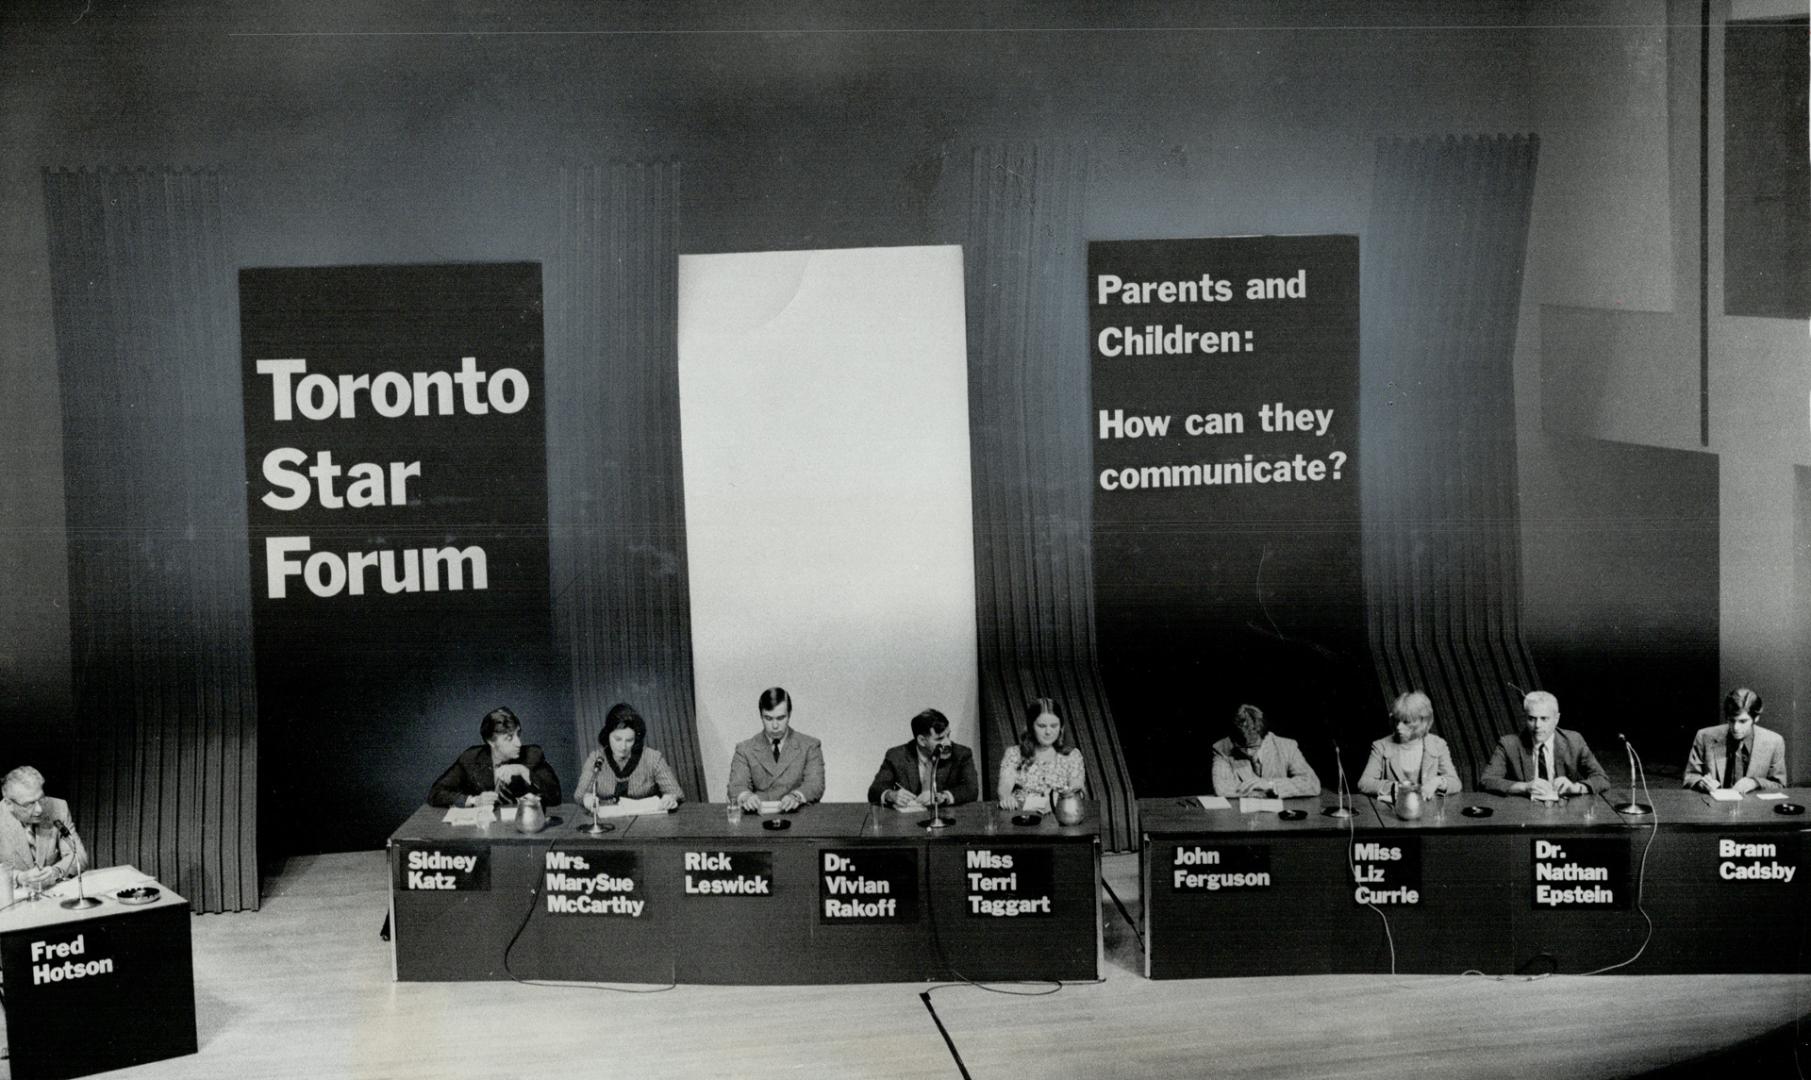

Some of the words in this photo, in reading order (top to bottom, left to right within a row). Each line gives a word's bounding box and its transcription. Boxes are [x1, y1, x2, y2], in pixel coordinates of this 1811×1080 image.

[1098, 274, 1232, 304] Parents
[1247, 270, 1306, 299] and
[1098, 325, 1253, 356] Children:
[257, 357, 529, 420] Toronto
[1100, 410, 1171, 439] How
[1185, 413, 1243, 435] can
[1259, 403, 1333, 436] they
[261, 447, 421, 511] Star
[1100, 451, 1346, 490] communicate?
[266, 536, 487, 598] Forum
[1174, 847, 1219, 865] John
[1355, 843, 1402, 861] Miss
[1536, 841, 1566, 858] Dr.
[1720, 840, 1776, 857] Bram
[408, 851, 476, 872] Sidney
[546, 852, 589, 869] Mrs.
[685, 852, 731, 870] Rick
[825, 853, 855, 871] Dr.
[967, 851, 1013, 868] Miss
[408, 871, 456, 889] Katz
[1174, 870, 1270, 890] Ferguson
[1355, 865, 1385, 882] Liz
[1536, 863, 1607, 880] Nathan
[1720, 861, 1795, 882] Cadsby
[546, 873, 634, 894] MarySue
[685, 875, 768, 893] Leswick
[825, 876, 889, 894] Vivian
[968, 873, 1016, 891] Terri
[1355, 886, 1419, 904] Currie
[1537, 885, 1613, 906] Epstein
[548, 895, 644, 916] McCarthy
[826, 899, 896, 917] Rakoff
[968, 896, 1050, 916] Taggart
[31, 934, 84, 962] Fred
[33, 959, 113, 985] Hotson
